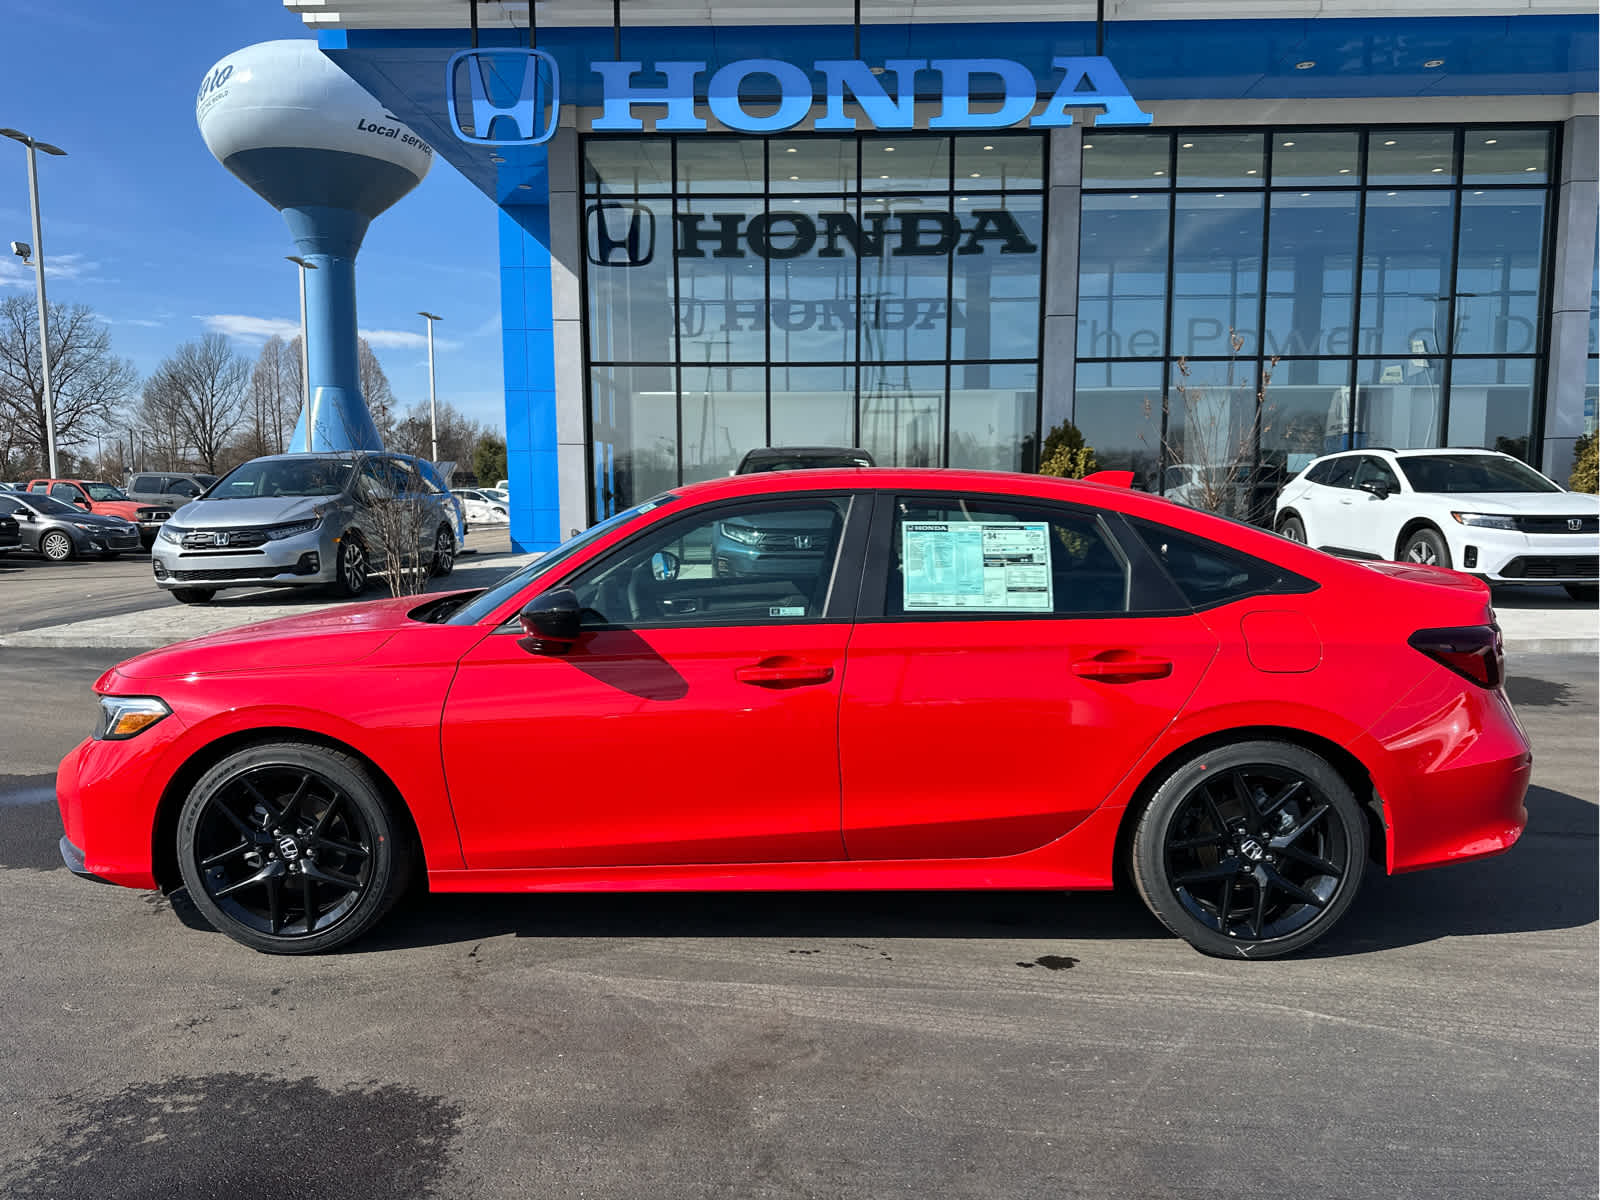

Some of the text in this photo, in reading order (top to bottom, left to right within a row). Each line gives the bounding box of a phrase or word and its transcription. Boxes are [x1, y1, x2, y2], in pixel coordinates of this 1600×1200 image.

[590, 56, 1153, 133] HONDA
[357, 118, 401, 138] Local
[675, 209, 1037, 260] HONDA
[1188, 316, 1384, 356] Power
